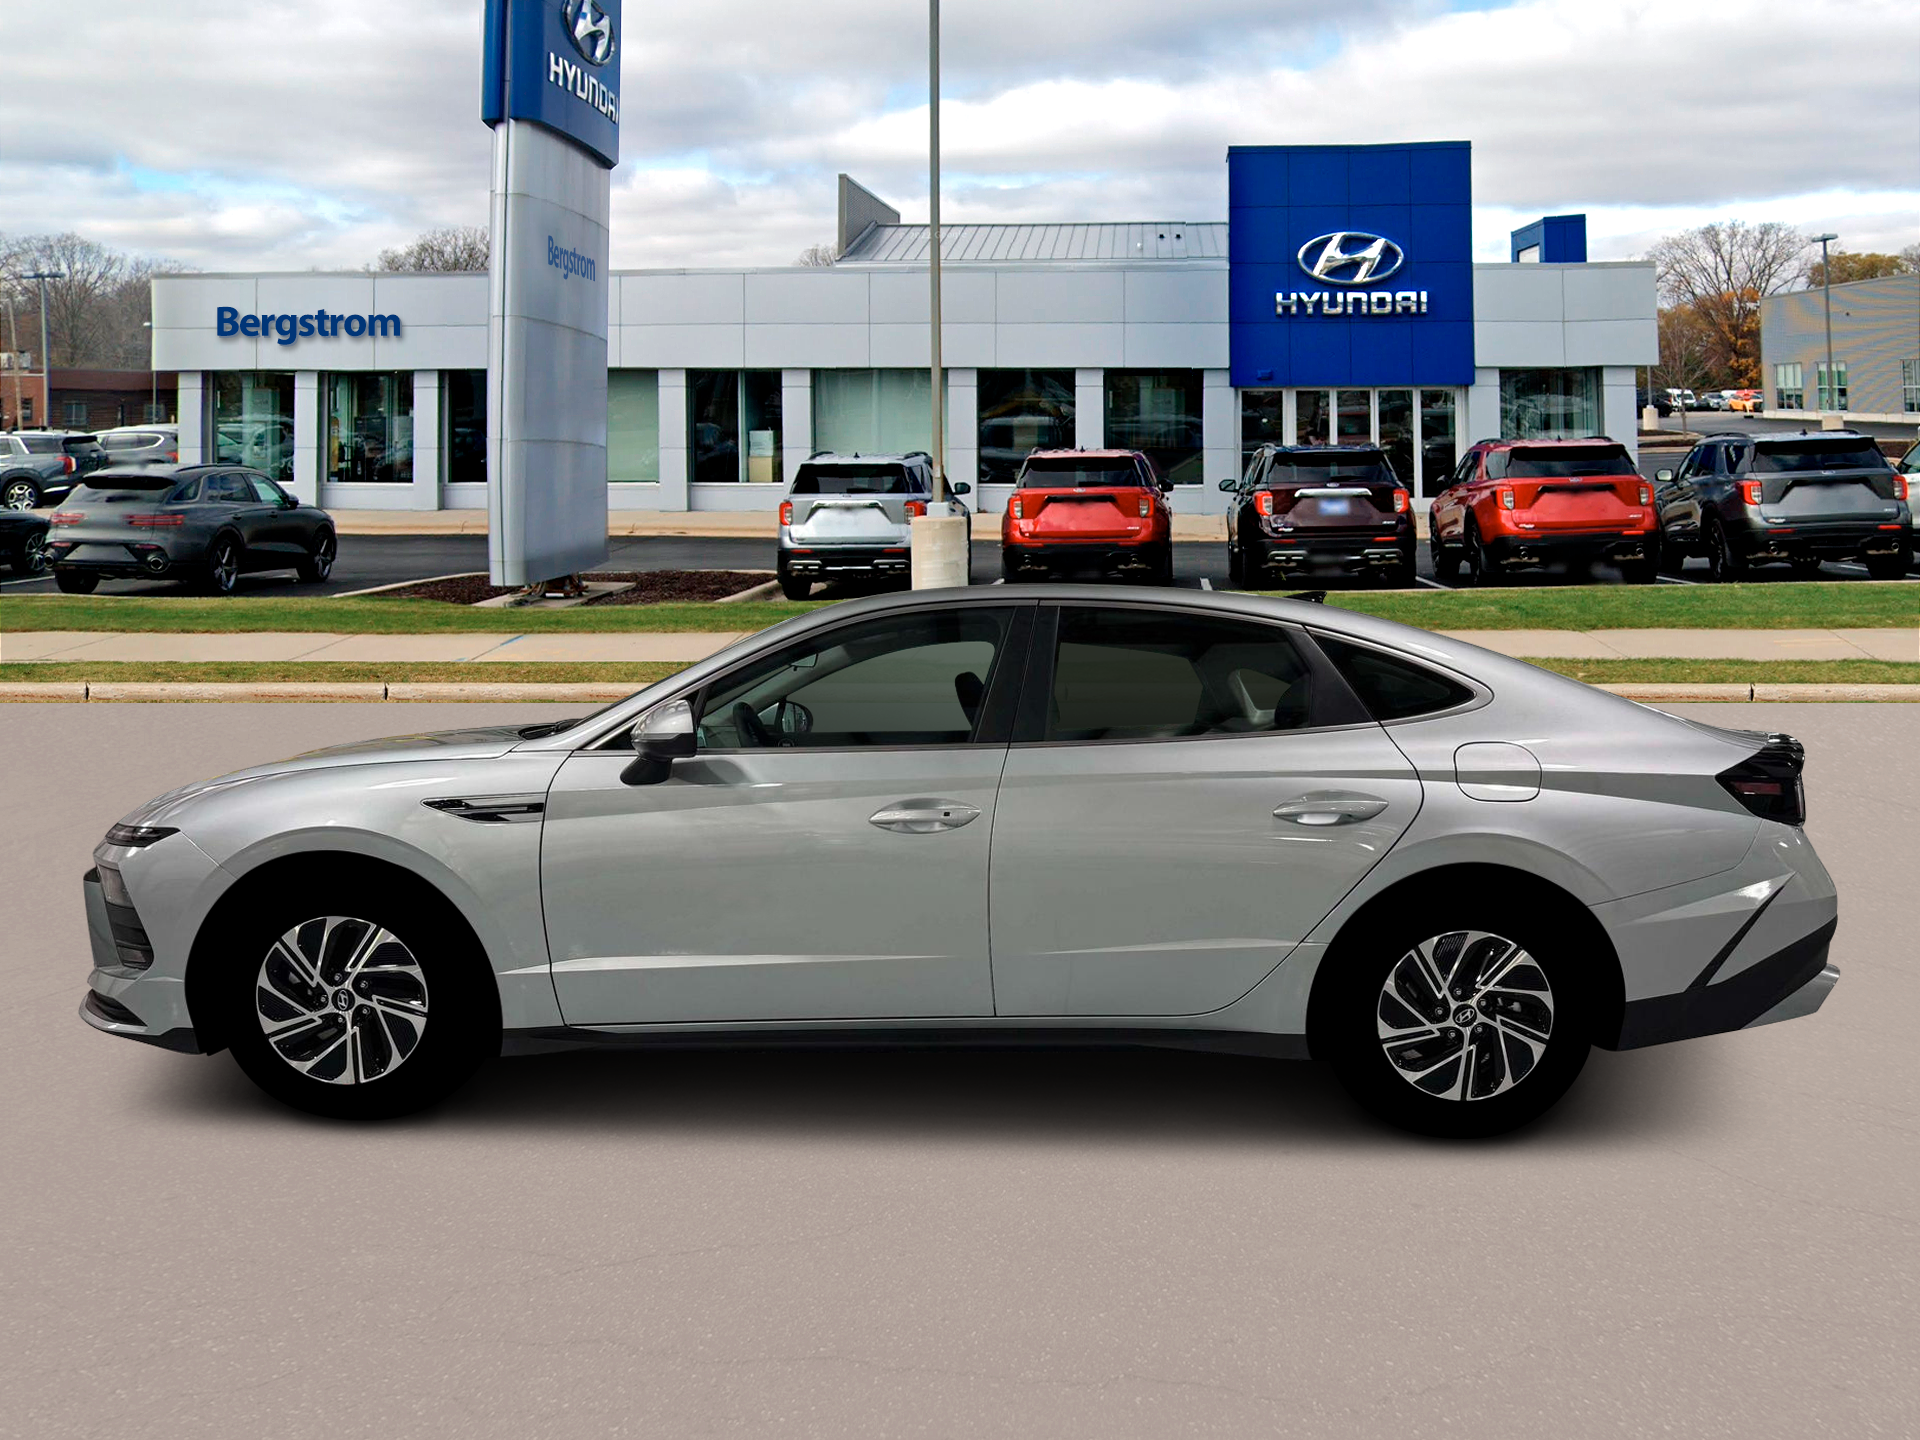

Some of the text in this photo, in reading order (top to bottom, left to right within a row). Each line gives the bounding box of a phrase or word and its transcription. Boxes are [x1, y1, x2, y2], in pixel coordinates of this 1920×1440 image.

[549, 52, 619, 124] HYUNDAI
[548, 235, 596, 281] Bergstrom
[1275, 292, 1428, 315] HYUNDAI
[216, 306, 402, 346] Bergstrom
